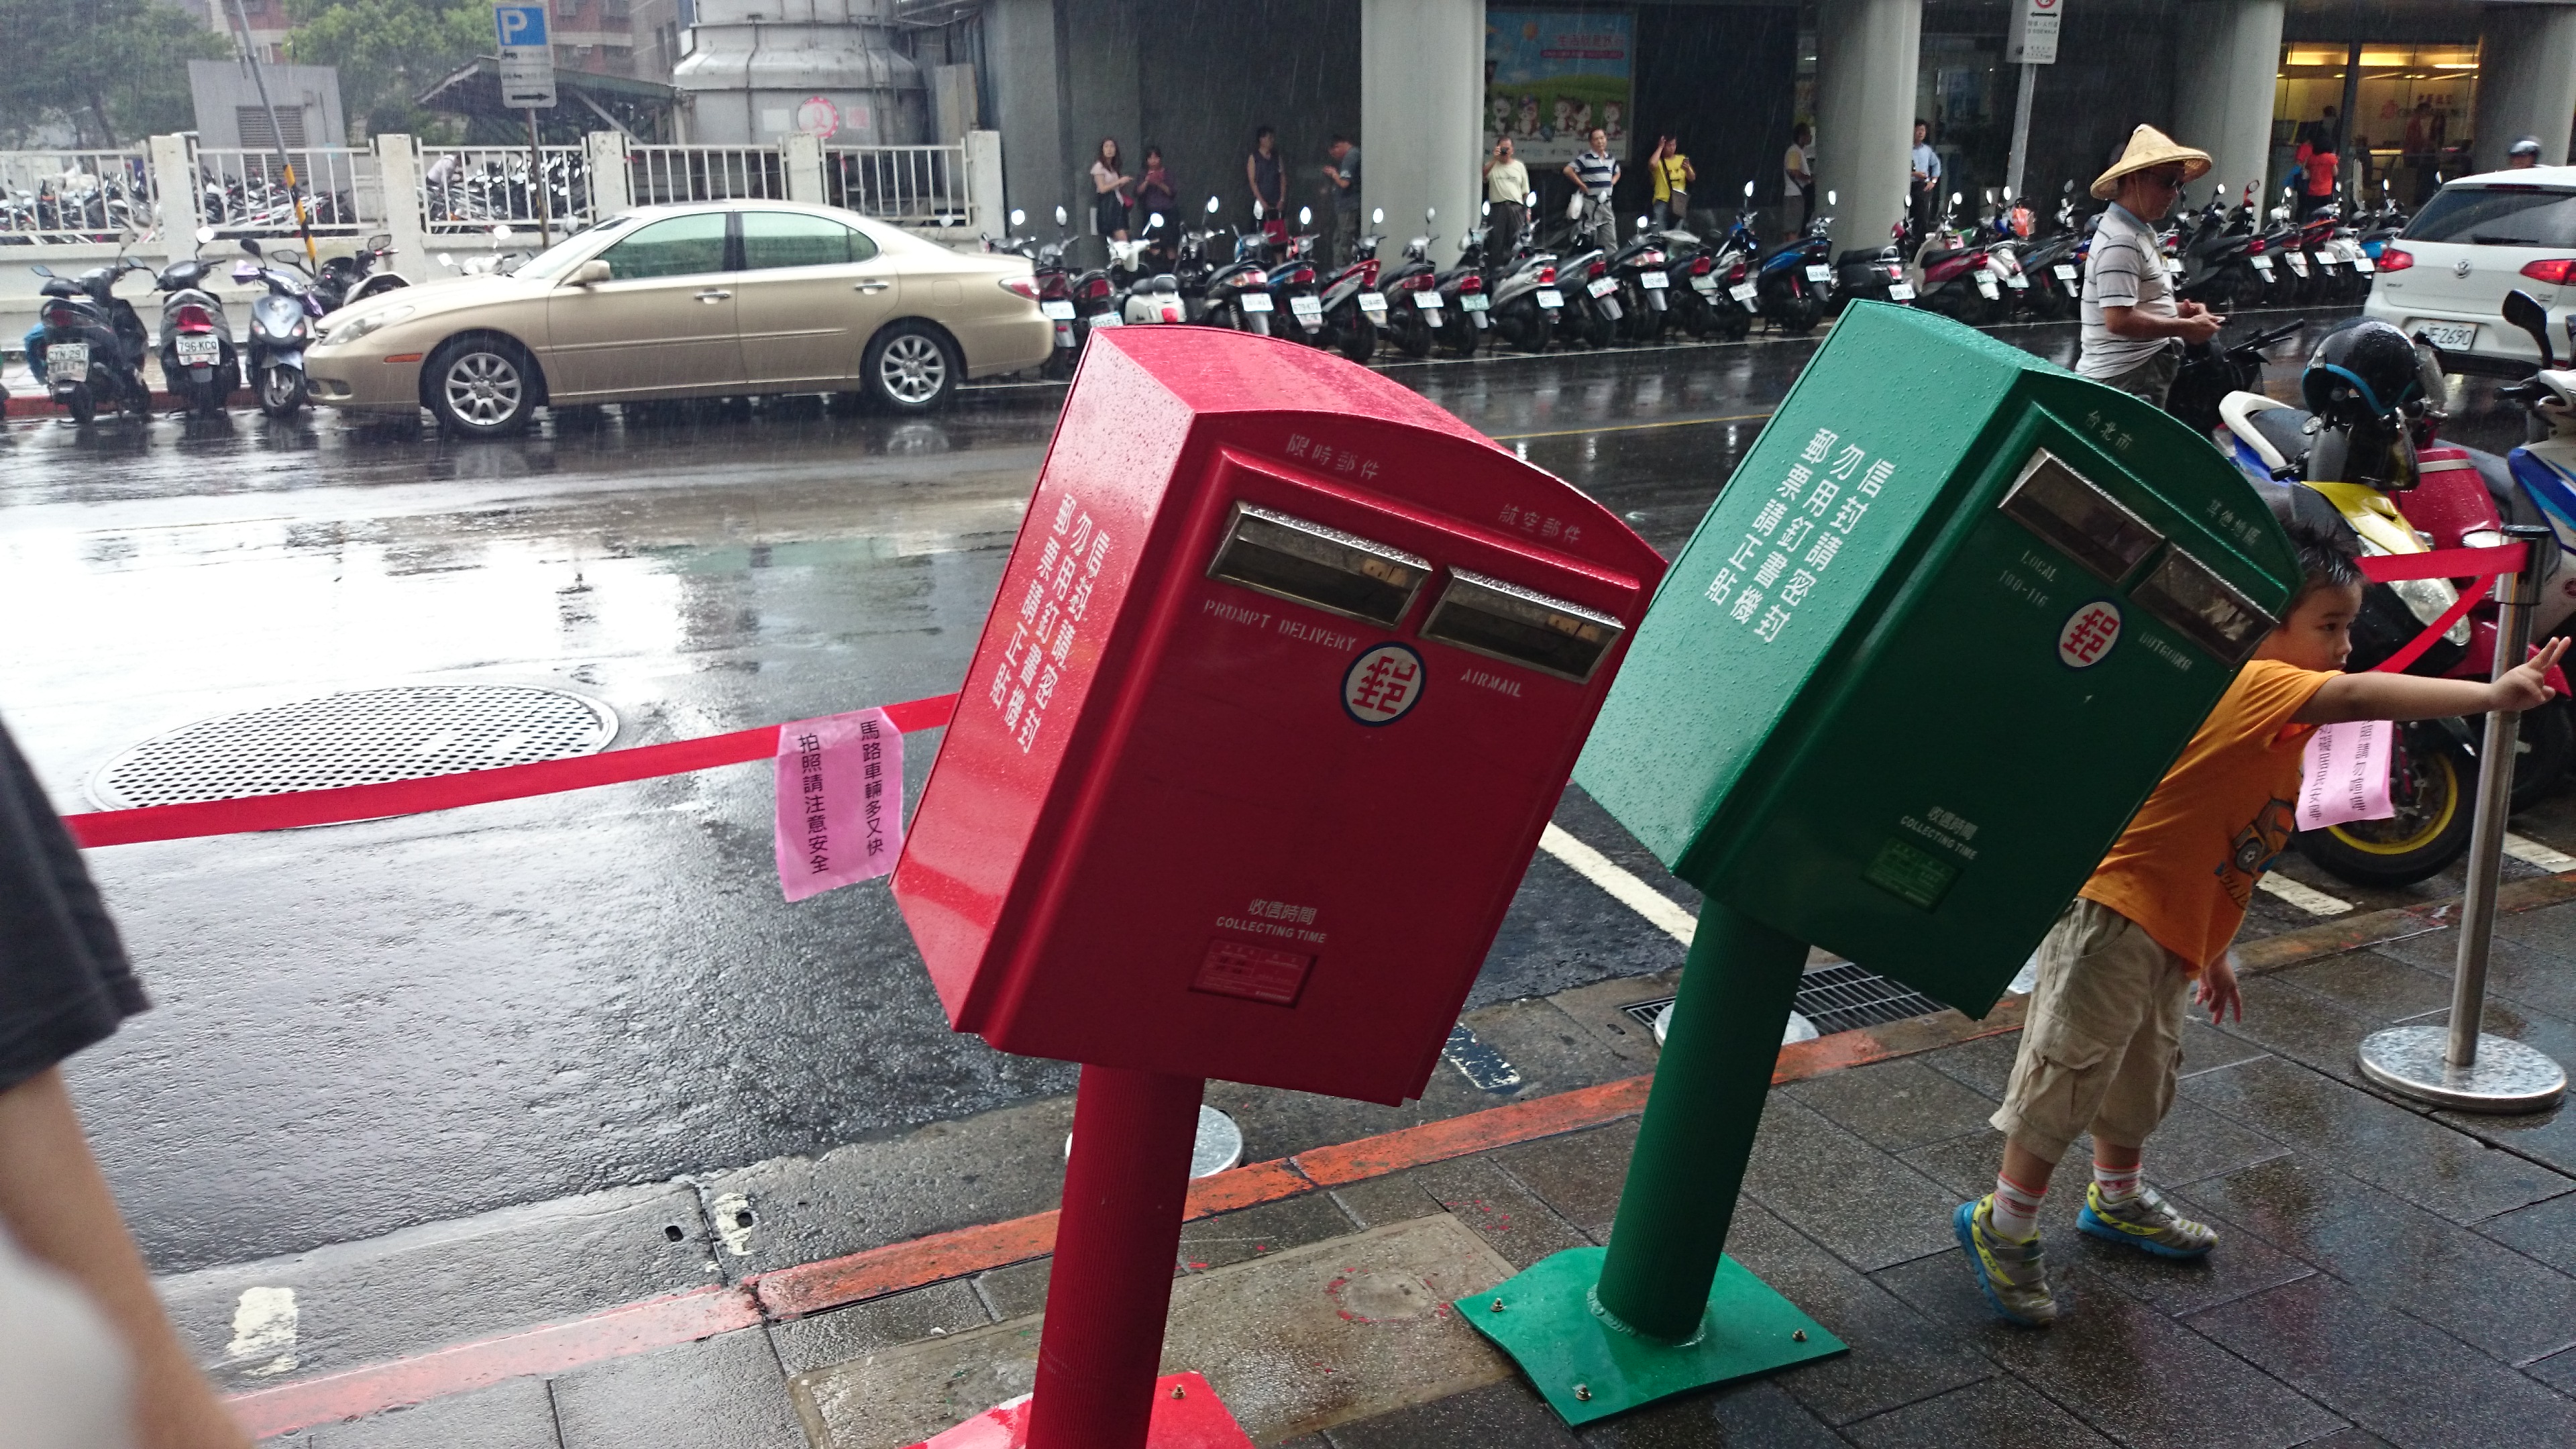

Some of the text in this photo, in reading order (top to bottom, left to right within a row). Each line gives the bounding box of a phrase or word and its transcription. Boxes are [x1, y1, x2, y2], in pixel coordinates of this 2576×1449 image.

[500, 9, 527, 44] P
[1285, 433, 1381, 481] 限時郵件
[1498, 502, 1582, 545] 航空郵件
[1705, 427, 1839, 606] 郵票請正貼
[1729, 443, 1866, 625] 勿用釘書機
[1753, 459, 1897, 643] 信封請密封
[2021, 549, 2057, 582] LOCAL
[989, 493, 1077, 710] 郵票請正貼
[1998, 570, 2049, 608] 100-116
[1005, 512, 1093, 733] 勿用釘書機
[1018, 529, 1111, 754] 信封請密封
[1201, 598, 1358, 652] PROMPT DELIVERY
[1459, 668, 1523, 698] AIRMAIL
[797, 733, 830, 875] 拍照請注意安全
[859, 720, 884, 857] 馬路車輛多又快
[1900, 815, 1978, 861] COLLECTING TIME
[1216, 916, 1328, 943] COLLECTING TIME
[1247, 898, 1318, 926] 收信時間
